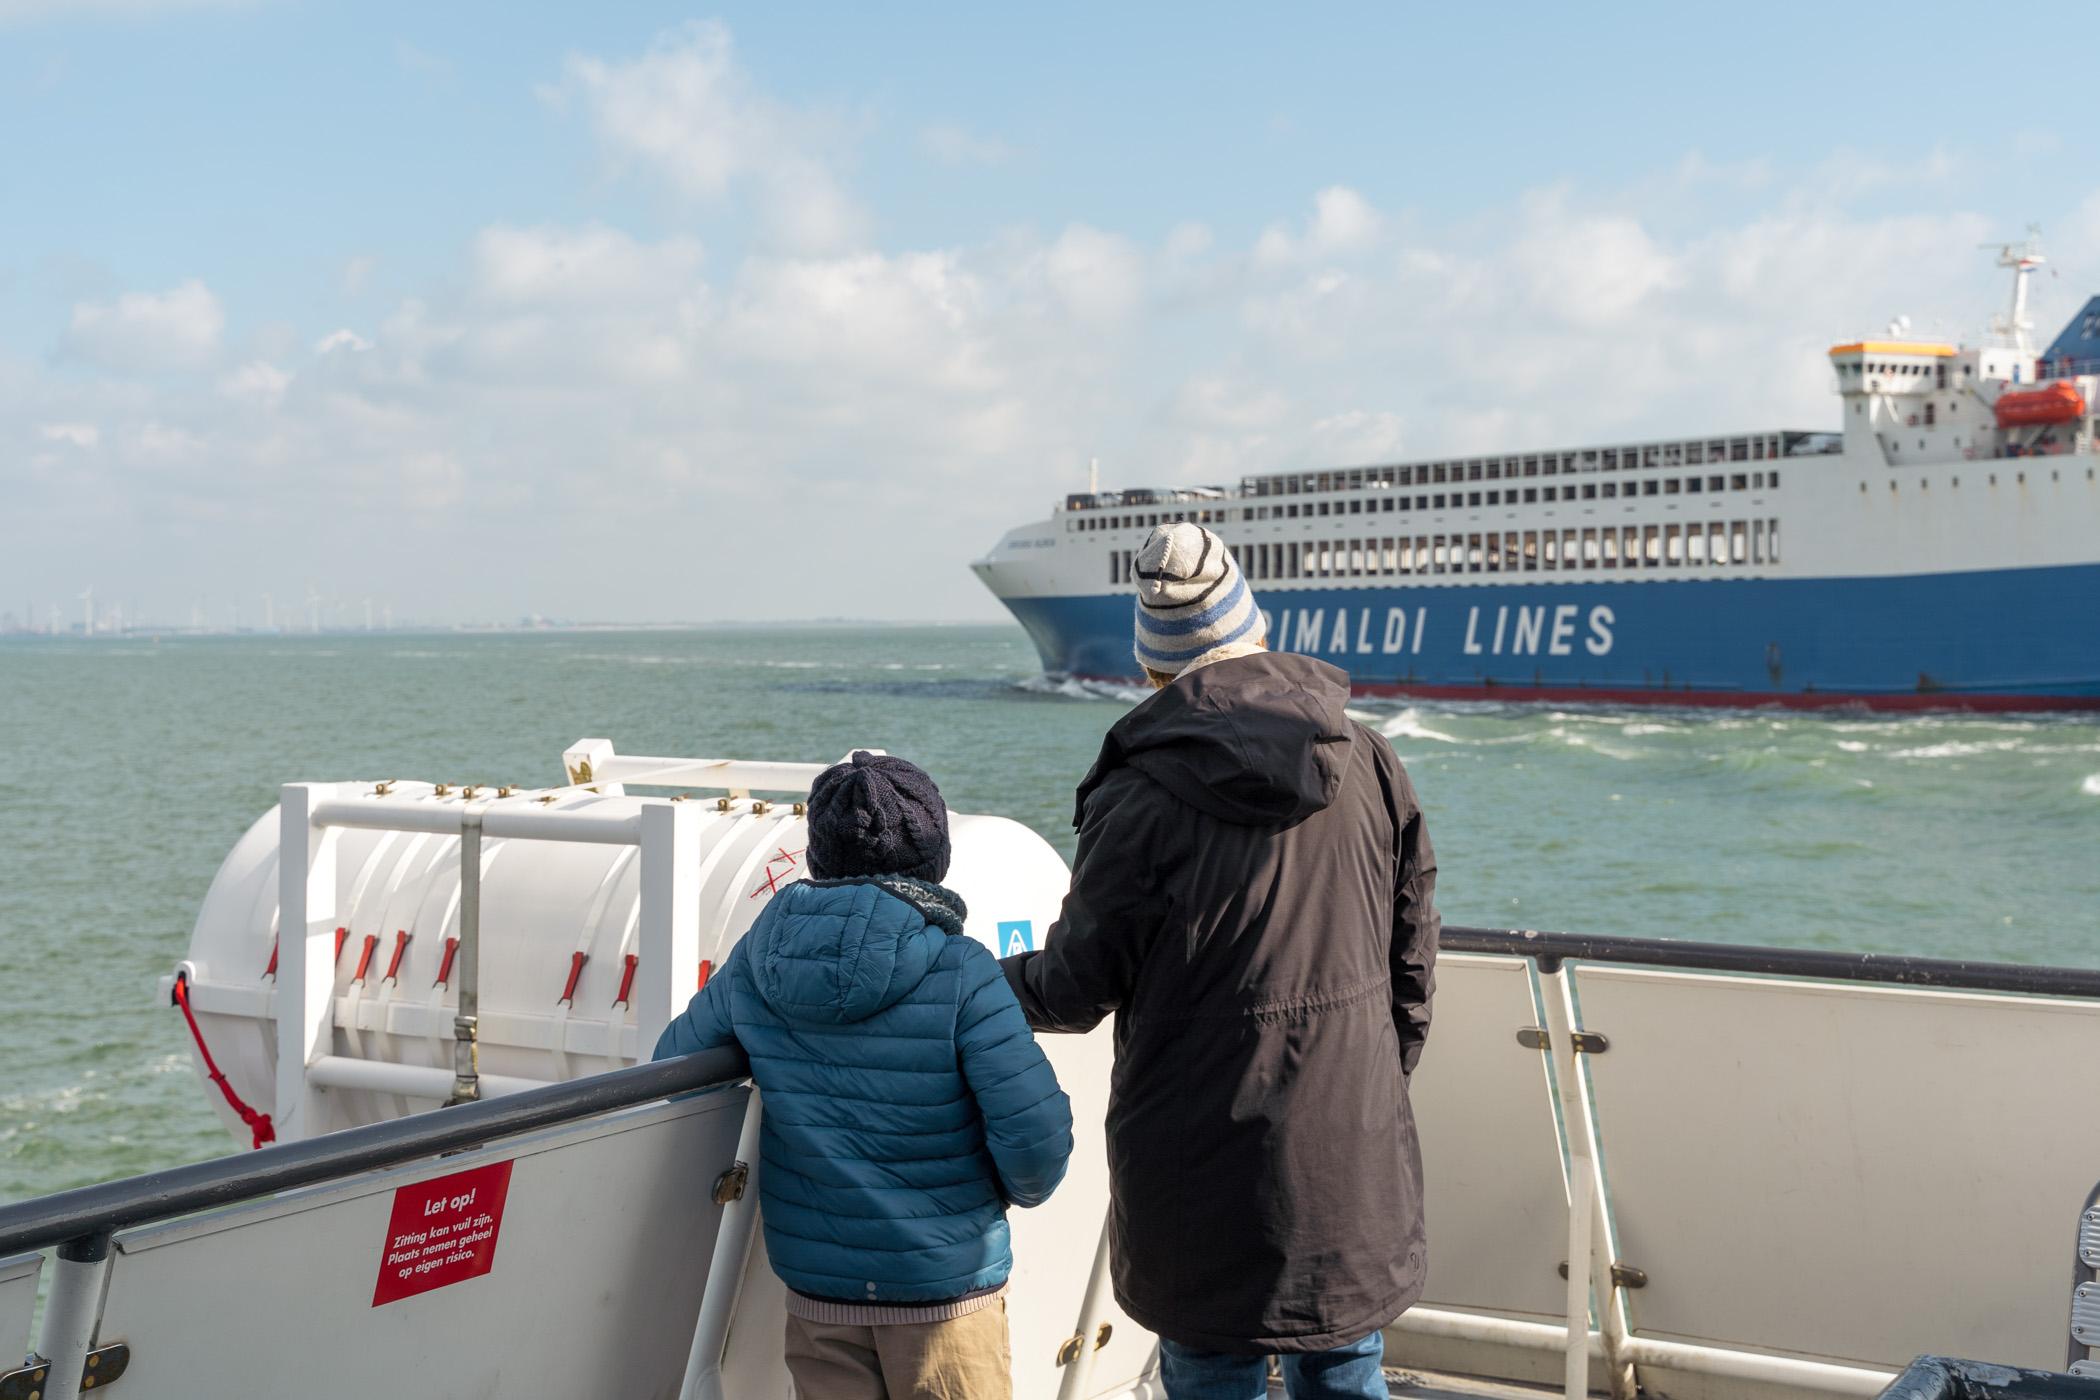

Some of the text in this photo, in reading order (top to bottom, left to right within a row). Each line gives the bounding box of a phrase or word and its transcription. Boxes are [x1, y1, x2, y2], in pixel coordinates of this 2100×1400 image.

[1463, 604, 1616, 656] LINES
[424, 1187, 476, 1216] Let op!
[387, 1226, 493, 1265] Plaats nemen geheel
[393, 1213, 493, 1249] Zitting kan vuil zijn.
[398, 1249, 475, 1279] op eigen risico.
